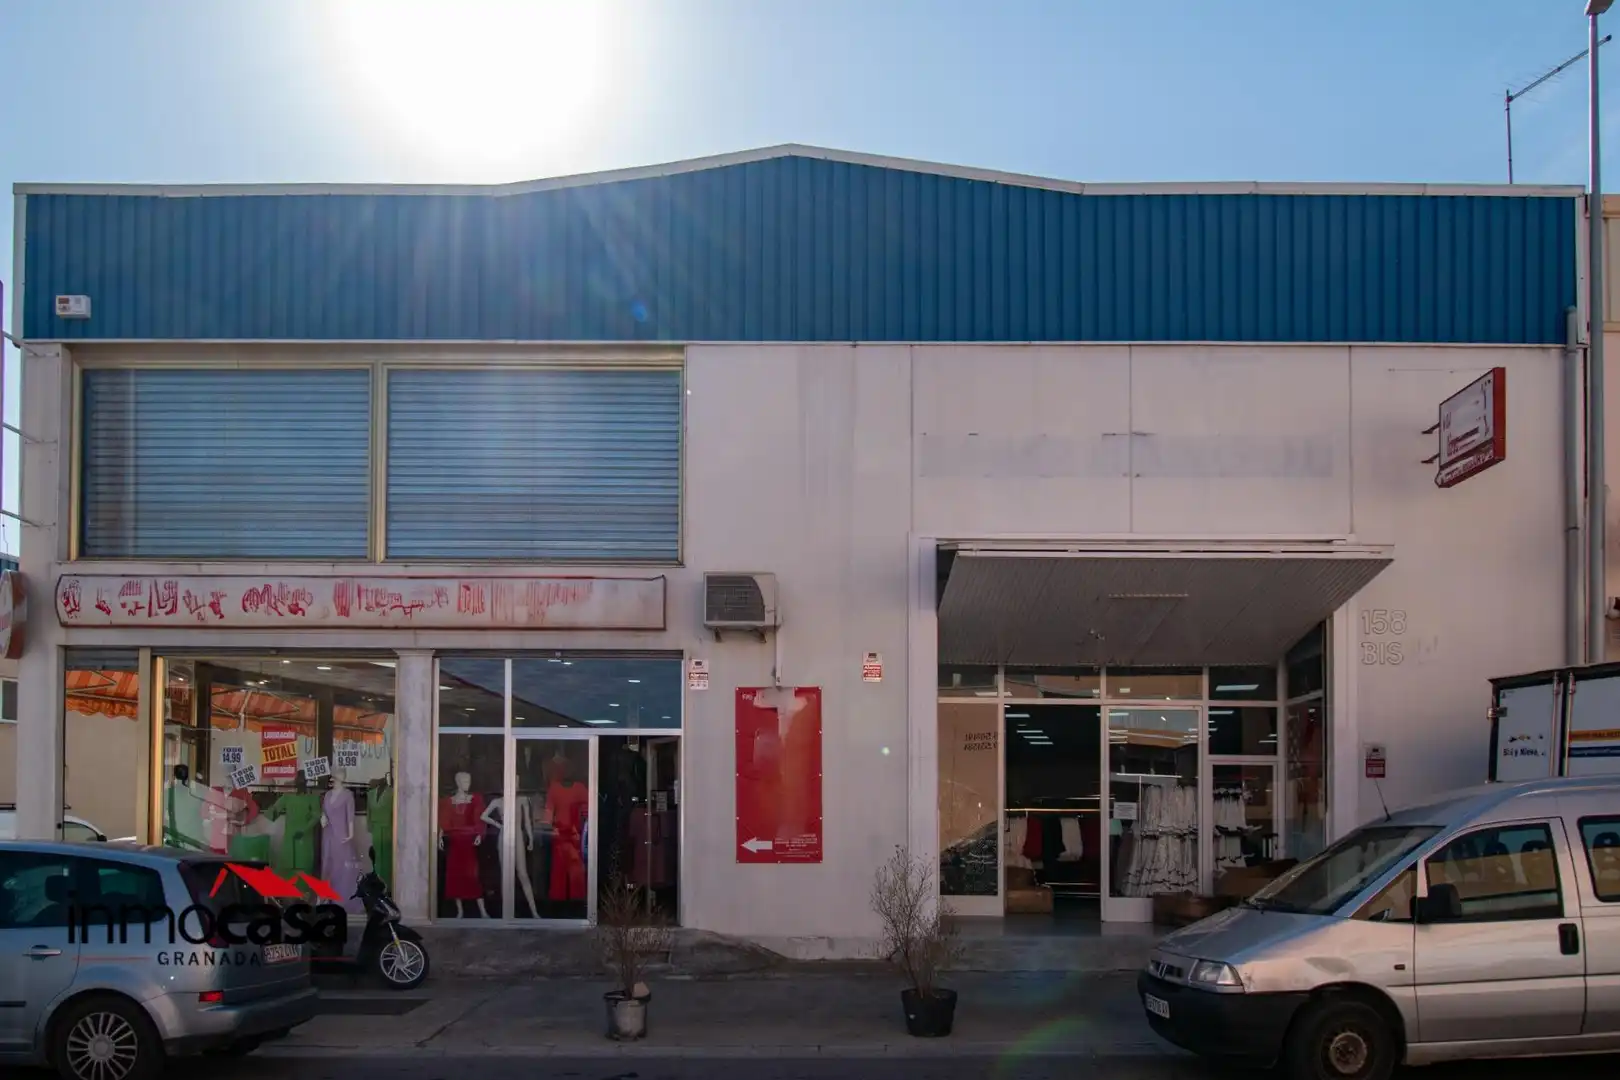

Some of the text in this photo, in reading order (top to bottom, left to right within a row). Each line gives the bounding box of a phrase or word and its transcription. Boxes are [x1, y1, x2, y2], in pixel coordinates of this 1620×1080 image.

[1361, 609, 1407, 635] 158
[1361, 641, 1404, 665] BIS
[263, 743, 296, 762] TOTAL!
